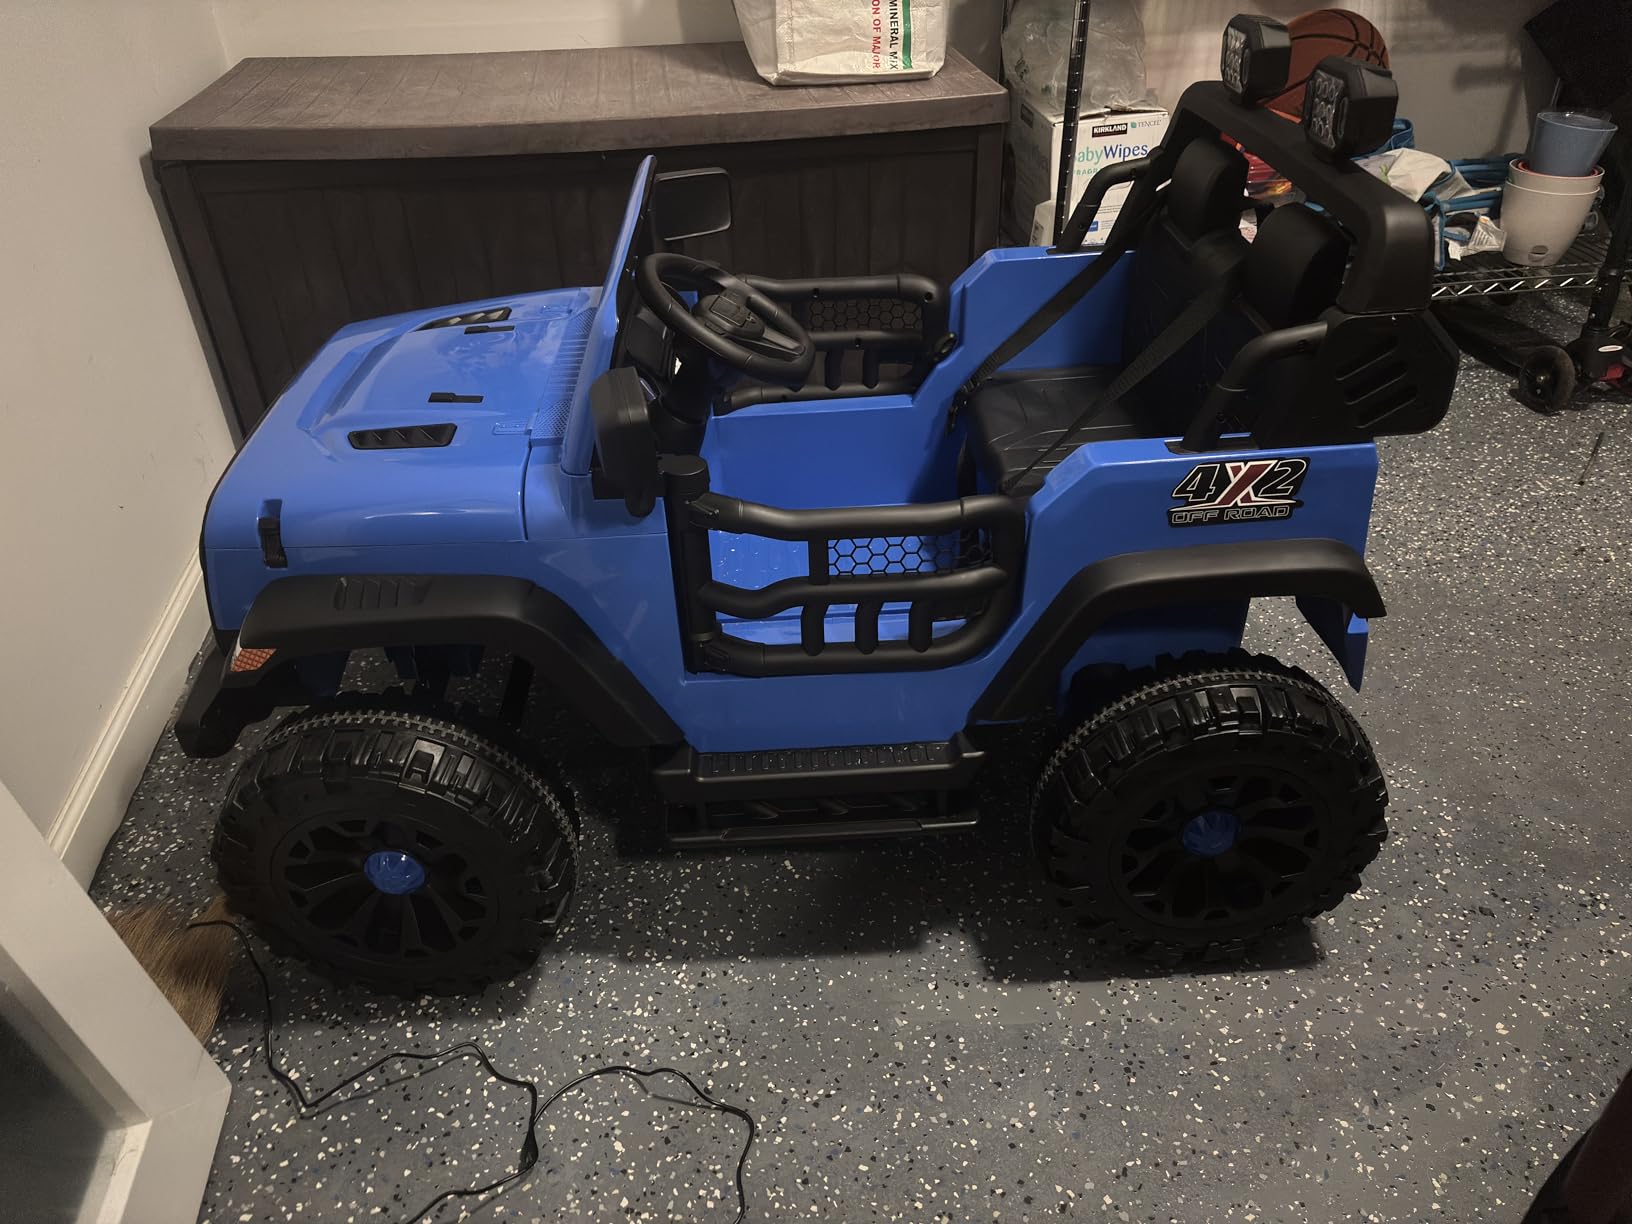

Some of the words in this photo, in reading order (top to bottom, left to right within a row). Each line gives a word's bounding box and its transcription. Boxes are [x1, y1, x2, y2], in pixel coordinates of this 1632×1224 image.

[873, 18, 882, 33] OF
[889, 0, 899, 49] MINERAL
[872, 36, 881, 69] MAJOR
[889, 51, 898, 70] MIX
[1093, 124, 1127, 134] KIRKLAND
[1171, 509, 1219, 524] OFF
[1223, 505, 1290, 520] ROAD
